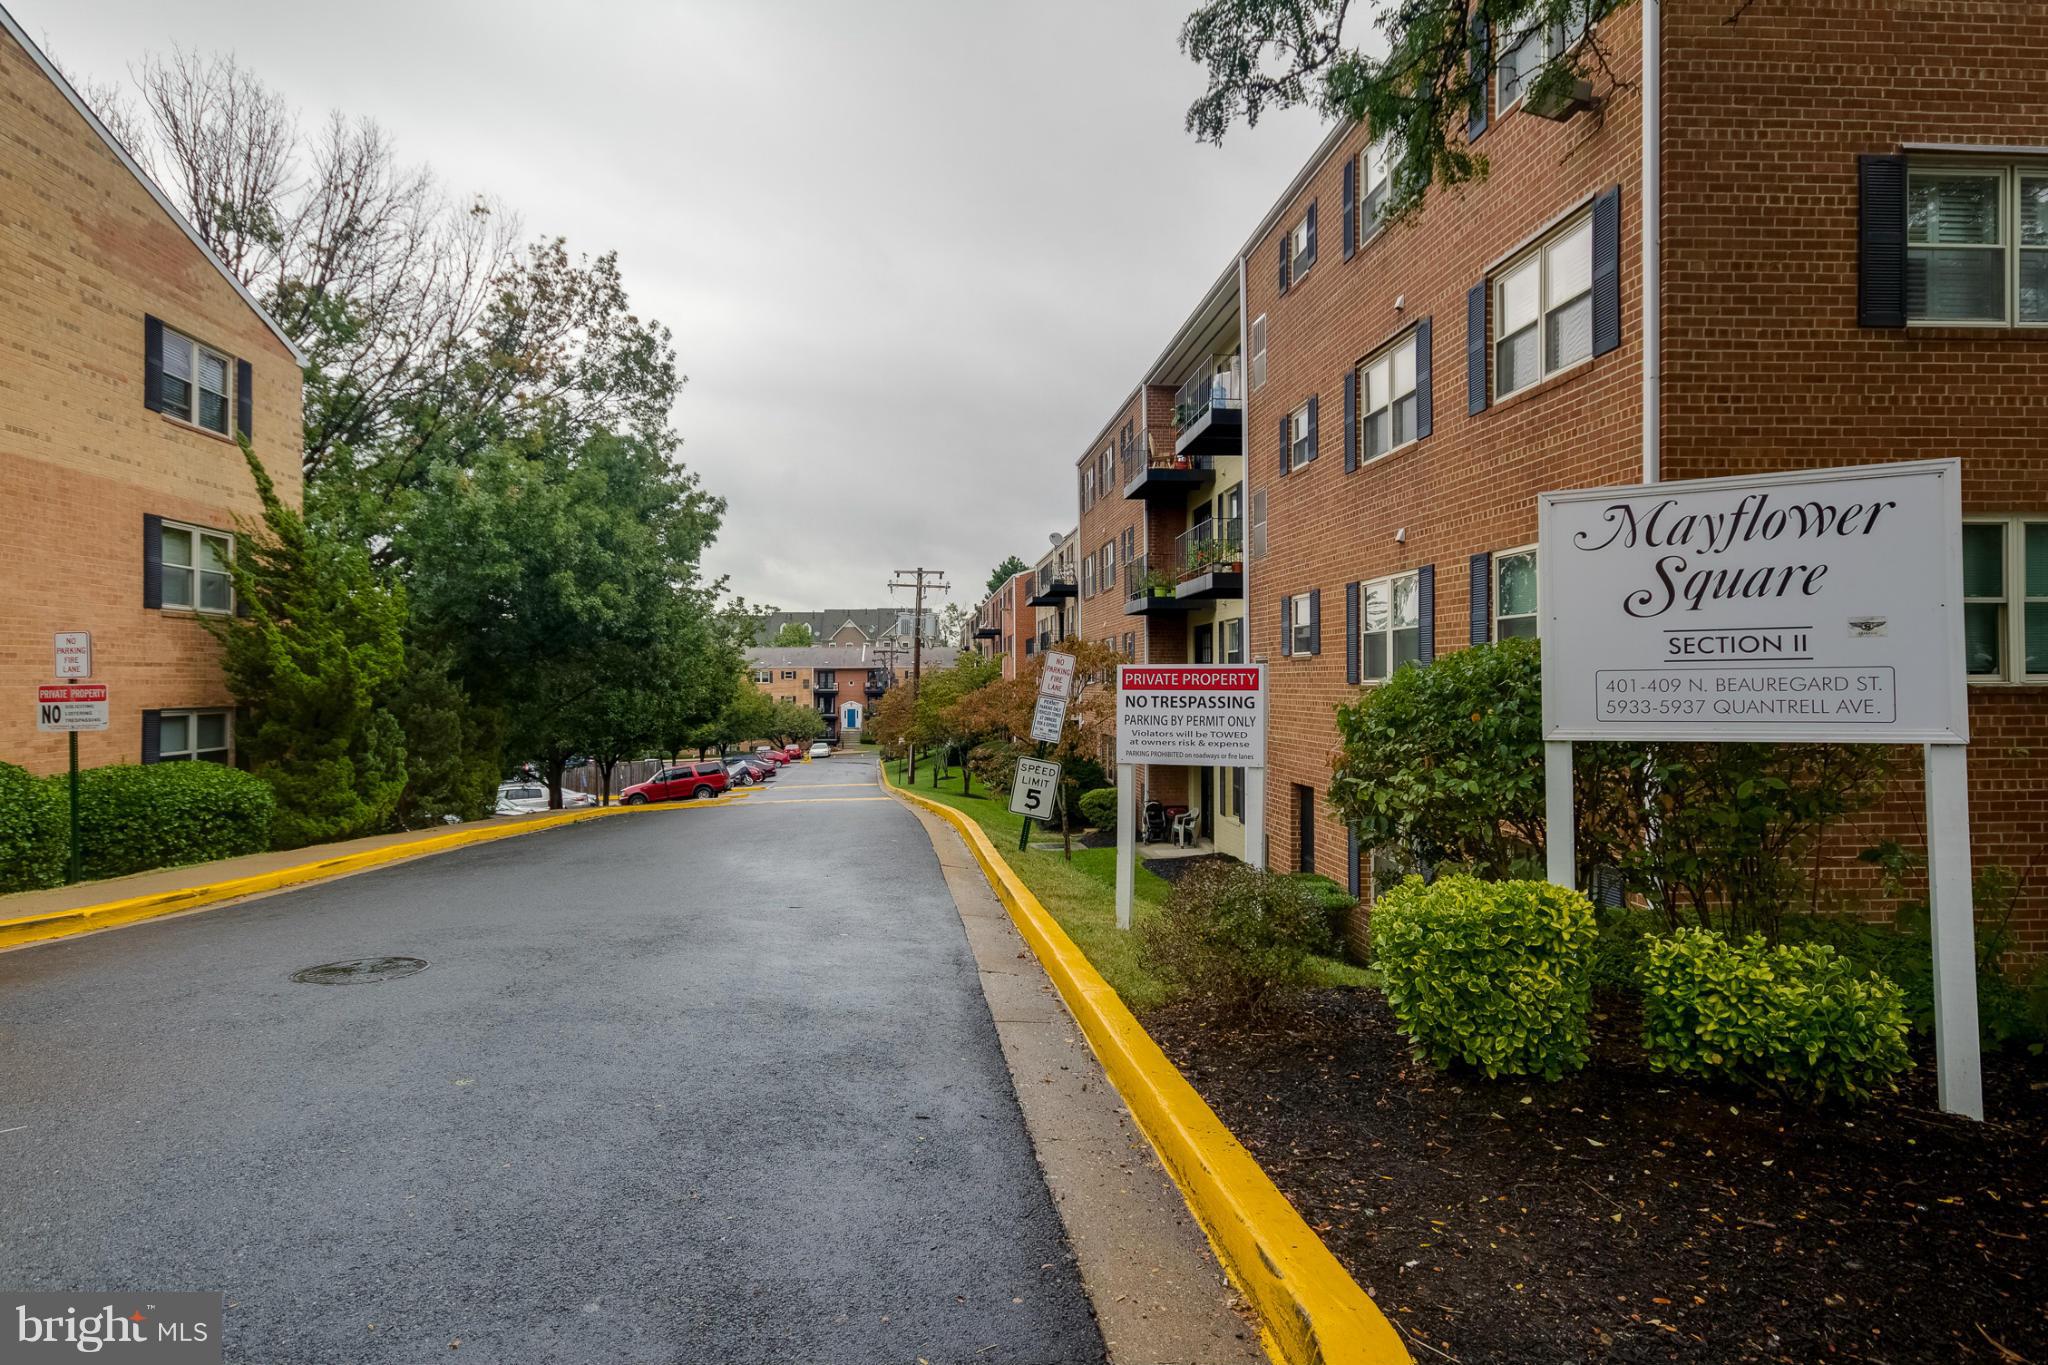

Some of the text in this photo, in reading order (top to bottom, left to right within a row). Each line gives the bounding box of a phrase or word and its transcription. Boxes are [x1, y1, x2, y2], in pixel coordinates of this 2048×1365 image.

[1573, 494, 1897, 556] Mayflower
[1623, 555, 1829, 618] Square
[65, 637, 76, 645] NO
[1668, 633, 1808, 656] SECTION II
[56, 647, 86, 655] PARKING
[64, 656, 79, 664] FIRE
[1056, 658, 1065, 666] NO
[63, 665, 80, 673] LANE
[1046, 665, 1071, 676] PARKING
[1051, 675, 1063, 684] FIRE
[1125, 672, 1256, 686] PRIVATE PROPERTY
[1605, 675, 1883, 693] 401-409 N. BEAUREGARD ST.
[40, 688, 106, 699] PRIVATE PROPERTY
[1047, 683, 1062, 692] LANE
[1125, 695, 1256, 709] NO TRESPASSING
[1605, 699, 1881, 714] 5933-5937 QUANTRELL AVE.
[41, 705, 62, 724] NO
[1124, 714, 1257, 727] PARKING BY PERMIT ONLY
[1131, 729, 1248, 739] Violators will be TOWED
[1129, 738, 1140, 746] at
[1178, 739, 1196, 747] risk
[1198, 739, 1206, 747] &
[1207, 740, 1250, 749] expense
[1151, 750, 1184, 758] PROHIBITED
[1193, 752, 1220, 760] roadways
[1020, 763, 1056, 778] SPEED
[1021, 774, 1051, 788] LIMIT
[1023, 788, 1042, 810] 5
